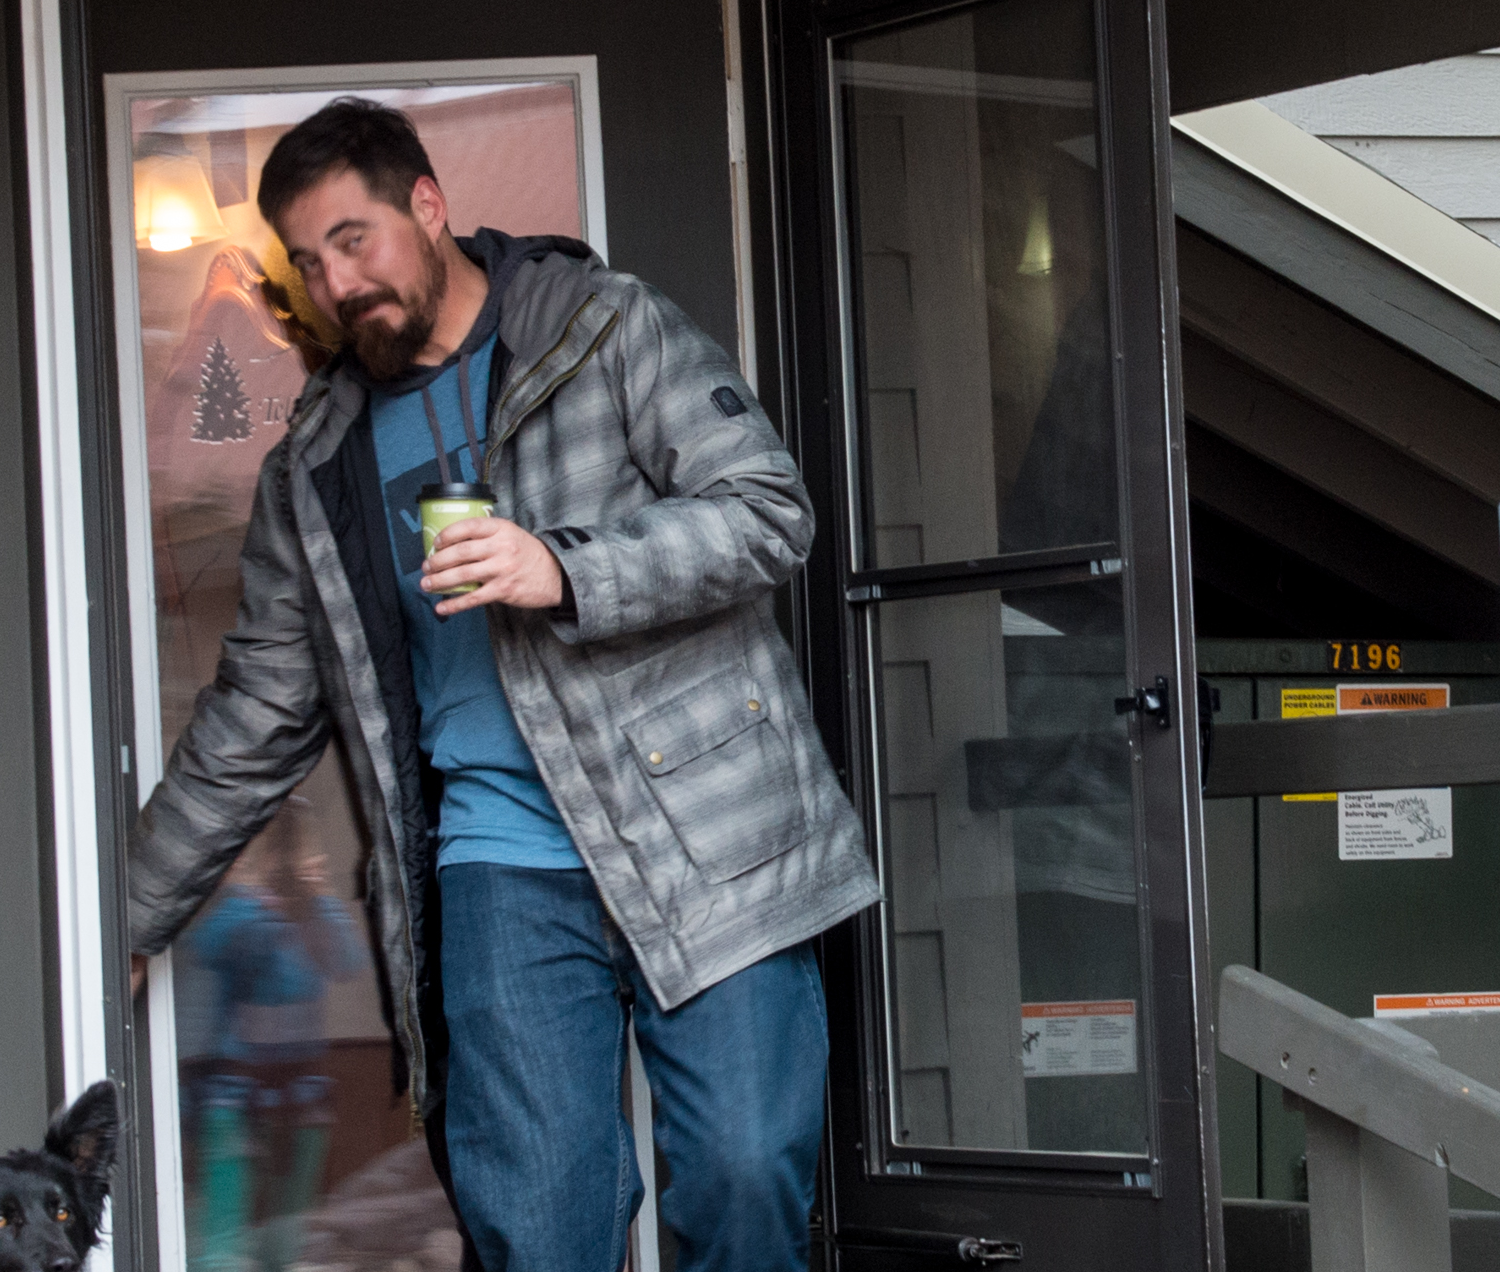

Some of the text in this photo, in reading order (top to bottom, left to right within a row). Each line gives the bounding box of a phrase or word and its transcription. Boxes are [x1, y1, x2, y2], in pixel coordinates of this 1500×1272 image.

[1331, 643, 1401, 670] 7196
[1373, 693, 1427, 706] WARNING
[1434, 998, 1466, 1006] WARNING
